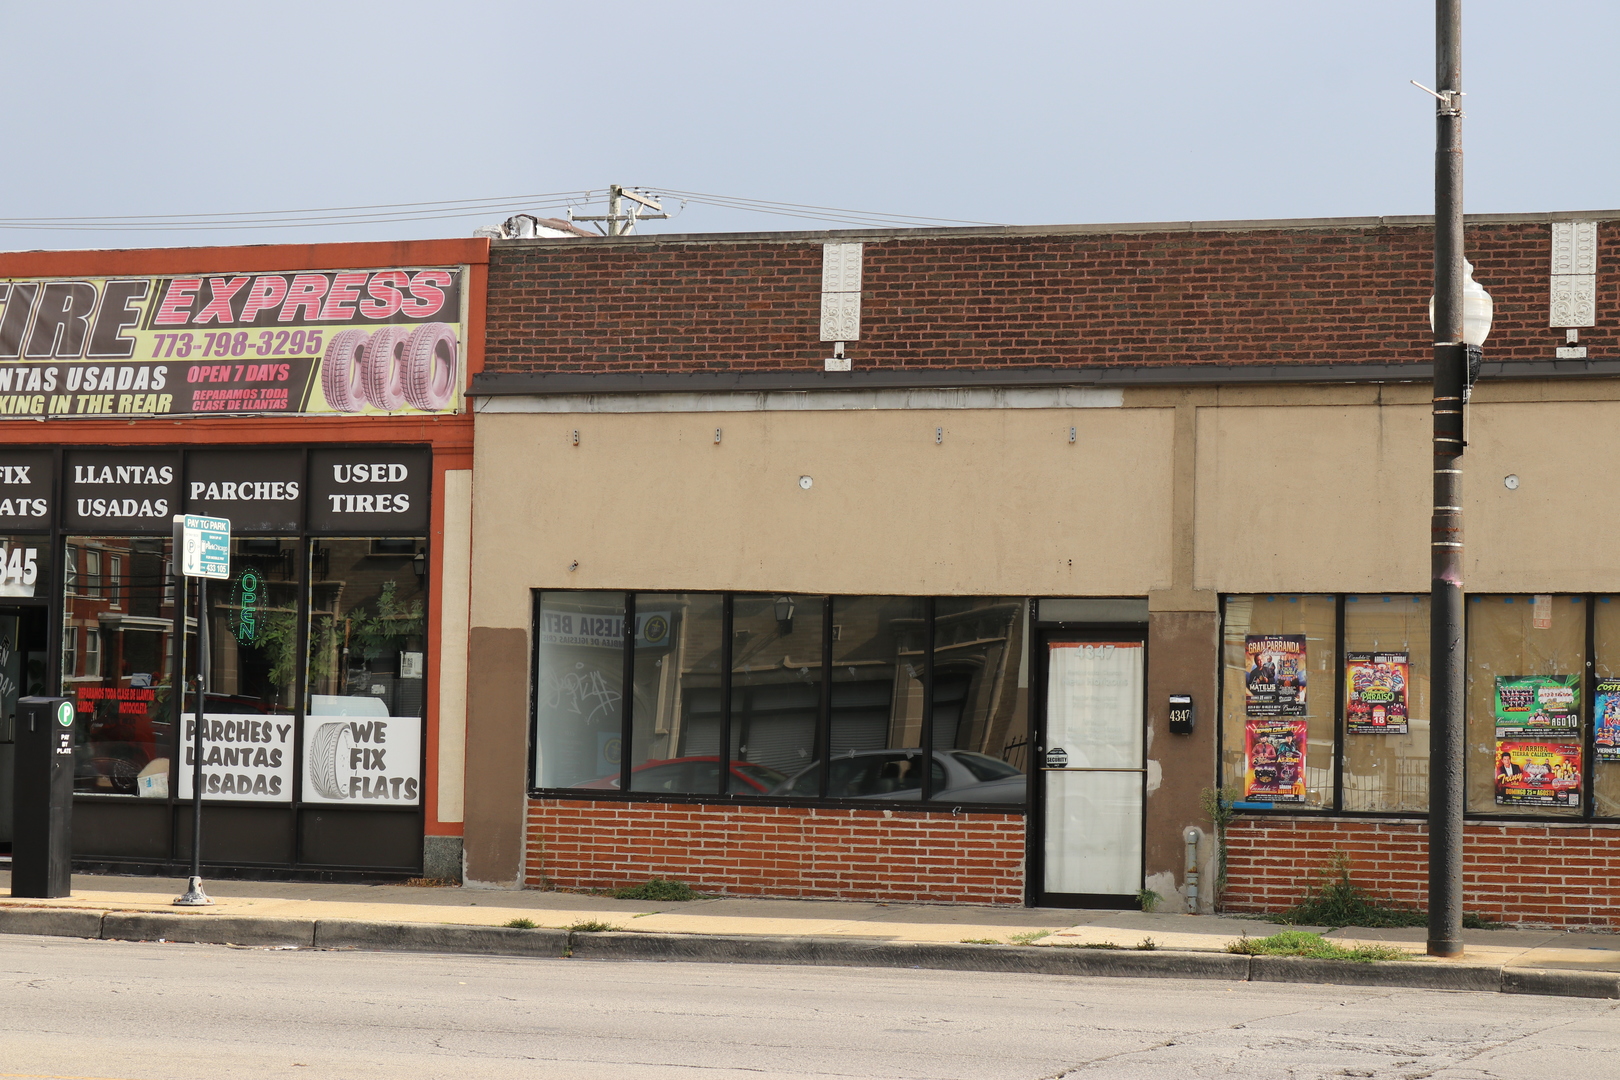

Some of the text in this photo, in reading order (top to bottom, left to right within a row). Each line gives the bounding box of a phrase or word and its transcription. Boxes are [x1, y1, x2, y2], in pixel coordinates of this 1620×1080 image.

[0, 270, 453, 359] IRE EXPRESS
[151, 330, 323, 358] 773-798-3295
[65, 365, 168, 392] USADAS
[187, 363, 290, 383] OPEN 7 DAYS
[48, 395, 72, 414] IN
[76, 394, 115, 414] THE
[117, 394, 173, 414] REAR
[192, 388, 289, 401] REPARAMOS TODA
[192, 399, 288, 411] CLASE DE LLANTAS
[74, 465, 173, 485] LLANTAS
[333, 464, 408, 483] USED
[189, 481, 300, 501] PARCHES
[76, 498, 168, 517] USADAS
[328, 493, 410, 513] TIRES
[187, 518, 226, 531] PAY TO PARK
[217, 565, 227, 573] 105
[239, 573, 257, 639] OPEN
[1075, 644, 1115, 660] 4347
[1248, 641, 1265, 654] GRAN
[1266, 640, 1300, 653] PARRANDA
[1169, 709, 1190, 722] 4347
[1373, 716, 1385, 724] 18
[1551, 718, 1566, 726] AGO
[1567, 715, 1577, 727] 10
[185, 719, 292, 743] PARCHES Y
[350, 721, 388, 744] WE
[350, 747, 386, 771] FIX
[350, 776, 418, 800] FLATS
[1292, 785, 1300, 795] 17
